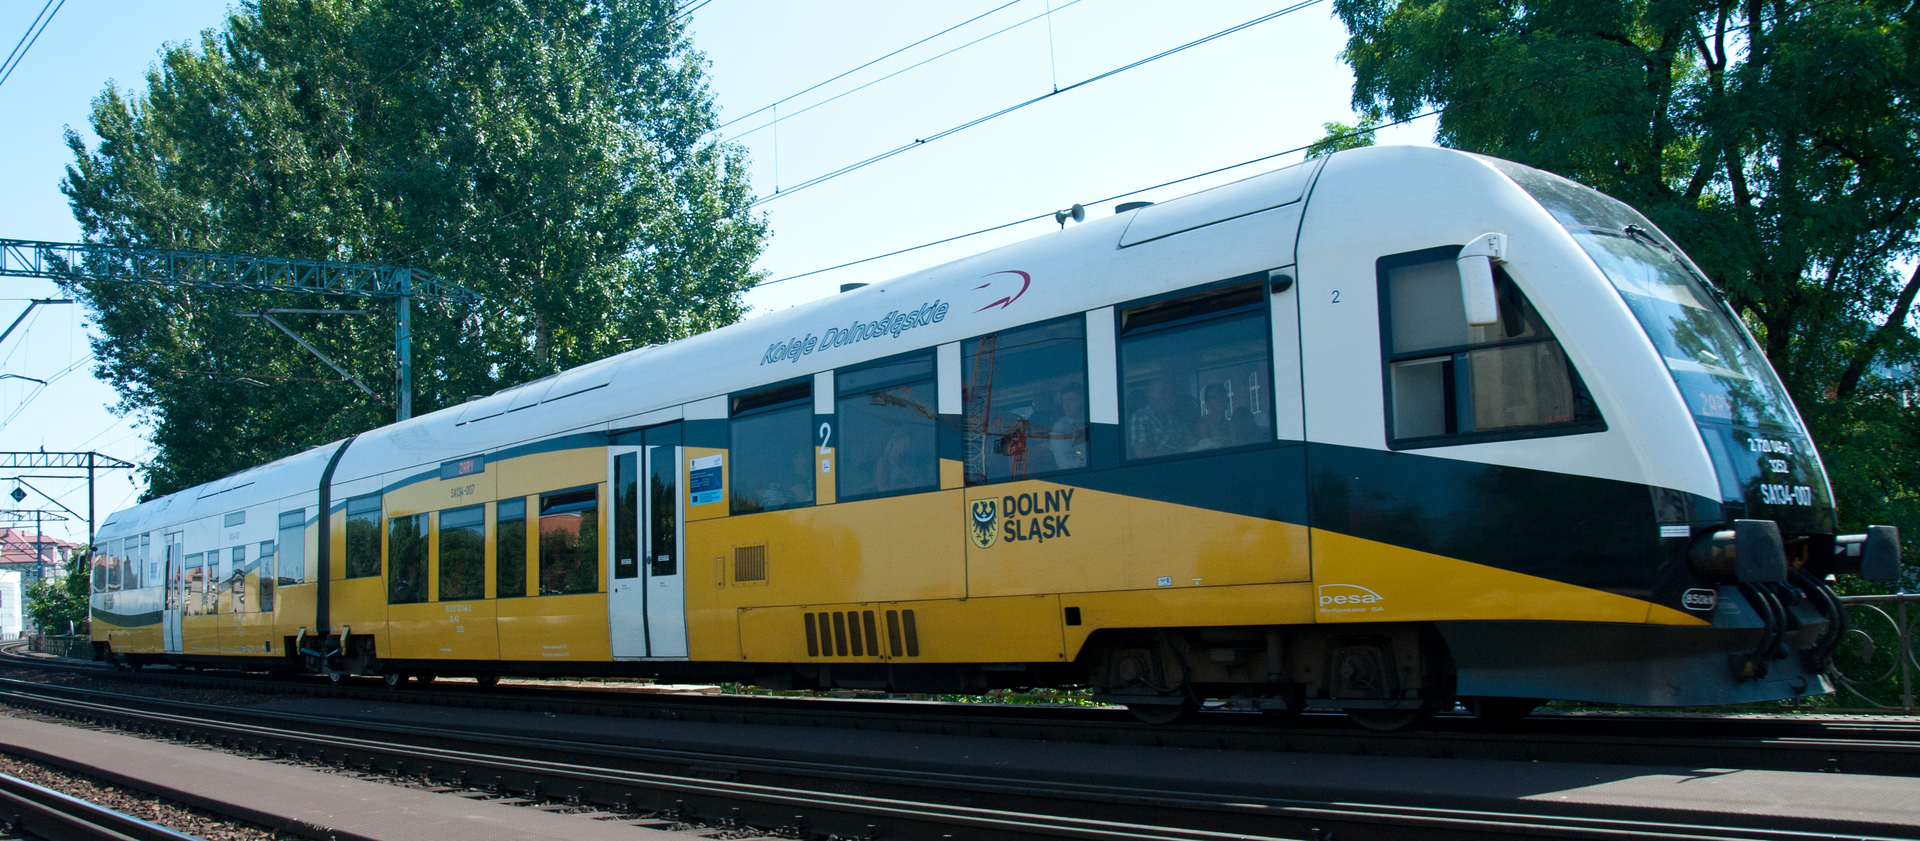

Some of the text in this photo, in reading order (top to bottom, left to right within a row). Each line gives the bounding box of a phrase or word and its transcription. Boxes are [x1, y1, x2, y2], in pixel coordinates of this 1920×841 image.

[1331, 289, 1341, 304] 2
[760, 299, 949, 366] Koleje Dolnośląskie
[819, 422, 832, 455] 2
[1003, 488, 1075, 517] DOLNY
[1760, 483, 1813, 507] SA134-007
[1004, 514, 1071, 544] ŚLĄSK
[1319, 594, 1377, 607] pesa
